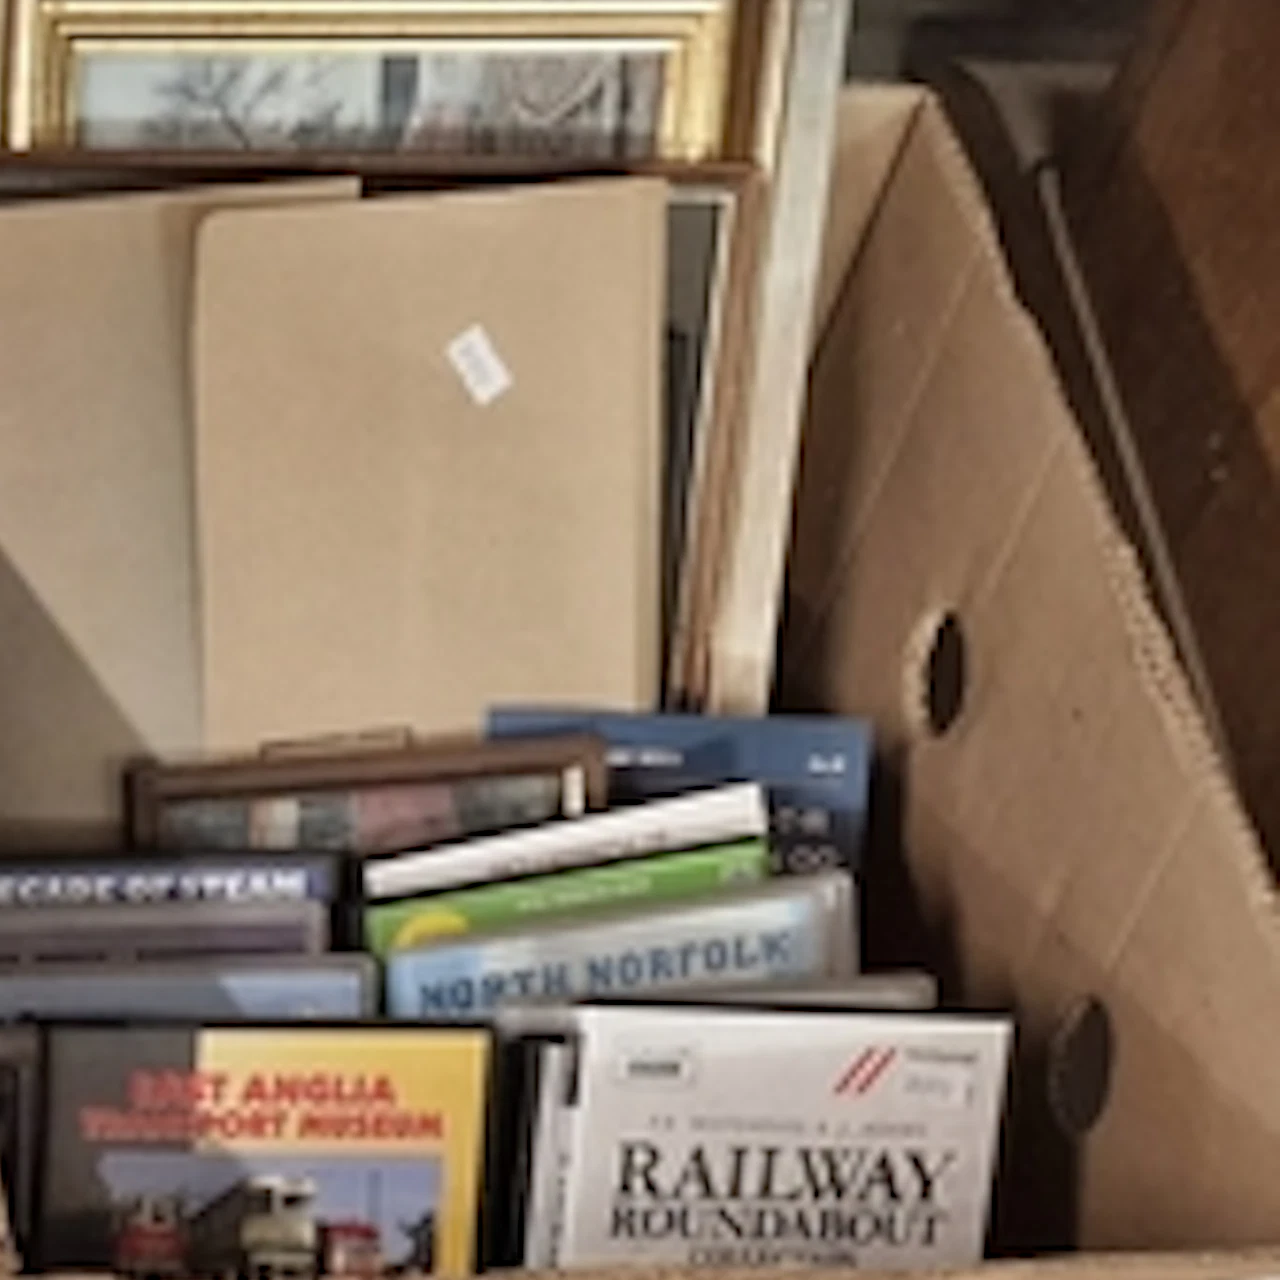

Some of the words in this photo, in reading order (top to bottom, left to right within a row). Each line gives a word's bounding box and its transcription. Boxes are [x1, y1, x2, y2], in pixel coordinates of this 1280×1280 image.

[180, 868, 308, 902] STEAM
[419, 960, 571, 1011] NORTH
[588, 931, 792, 997] NORFOLK
[128, 1071, 229, 1105] EAST
[245, 1072, 397, 1105] ANGLIA
[80, 1108, 290, 1141] TRANSPORT
[298, 1111, 446, 1140] MUSEUM
[617, 1139, 958, 1203] RAILWAY
[610, 1203, 952, 1248] ROUNDABOUT
